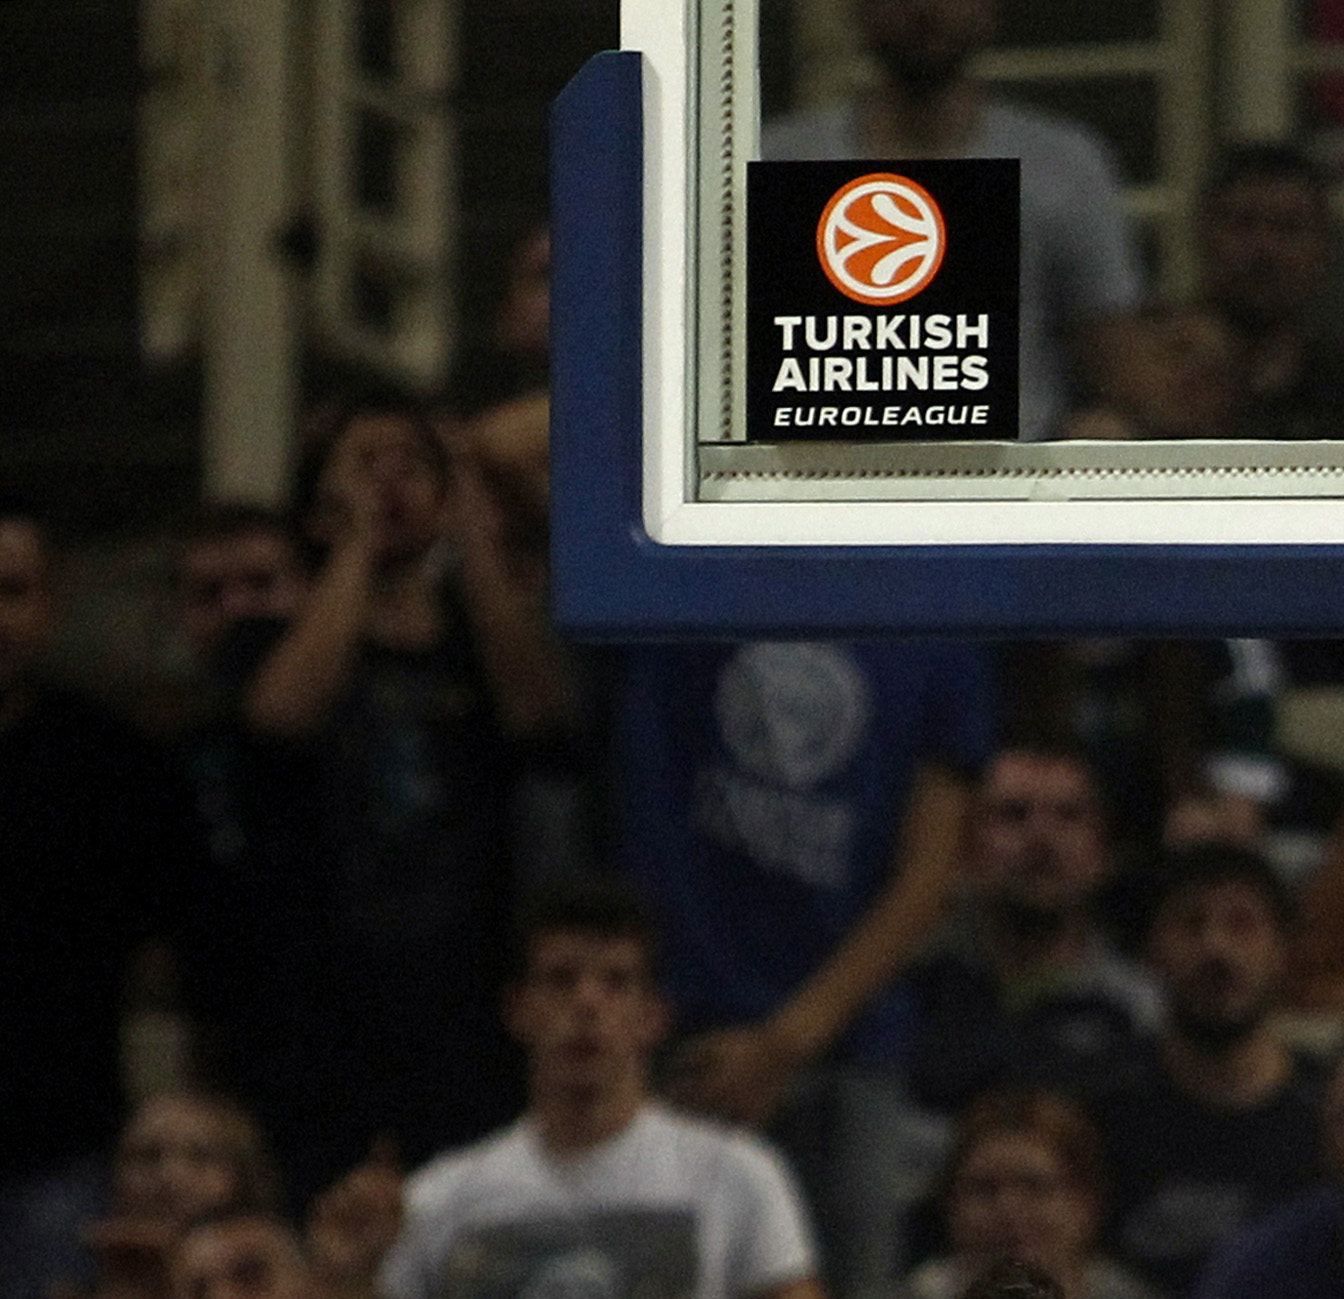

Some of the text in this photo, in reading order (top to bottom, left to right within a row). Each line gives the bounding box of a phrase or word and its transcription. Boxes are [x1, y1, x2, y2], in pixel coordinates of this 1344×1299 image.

[773, 314, 989, 351] TURKISH
[771, 355, 990, 392] AIRLINES
[773, 405, 990, 427] EUROLEAGUE
